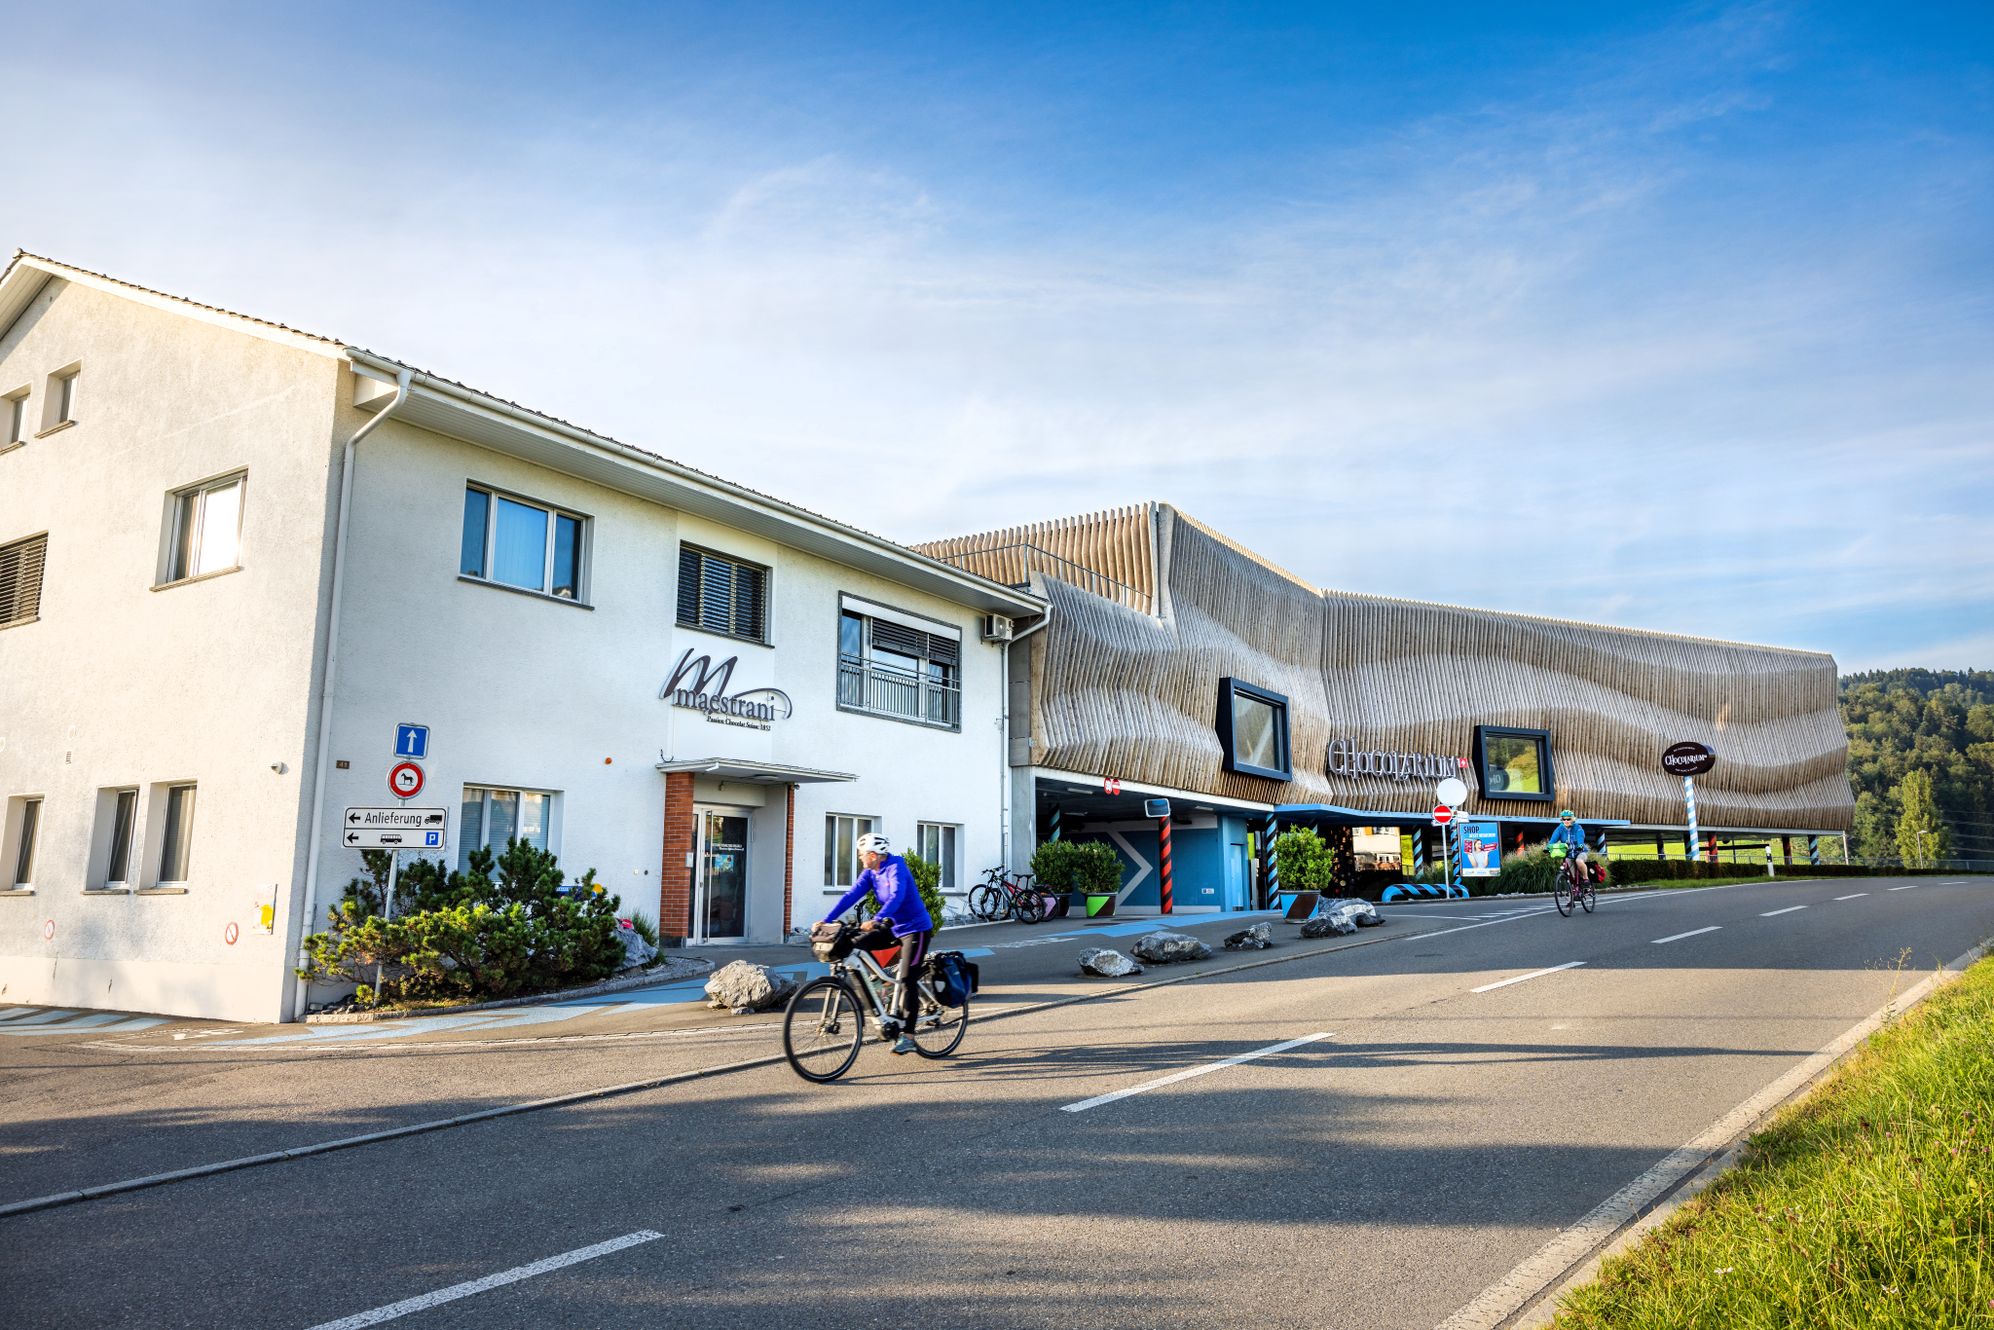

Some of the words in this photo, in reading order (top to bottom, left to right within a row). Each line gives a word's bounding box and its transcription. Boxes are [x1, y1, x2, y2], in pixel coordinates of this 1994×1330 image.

[675, 687, 775, 721] maestrani
[364, 812, 422, 827] Anlieferung
[1463, 825, 1480, 834] SHOP
[429, 834, 436, 844] P
